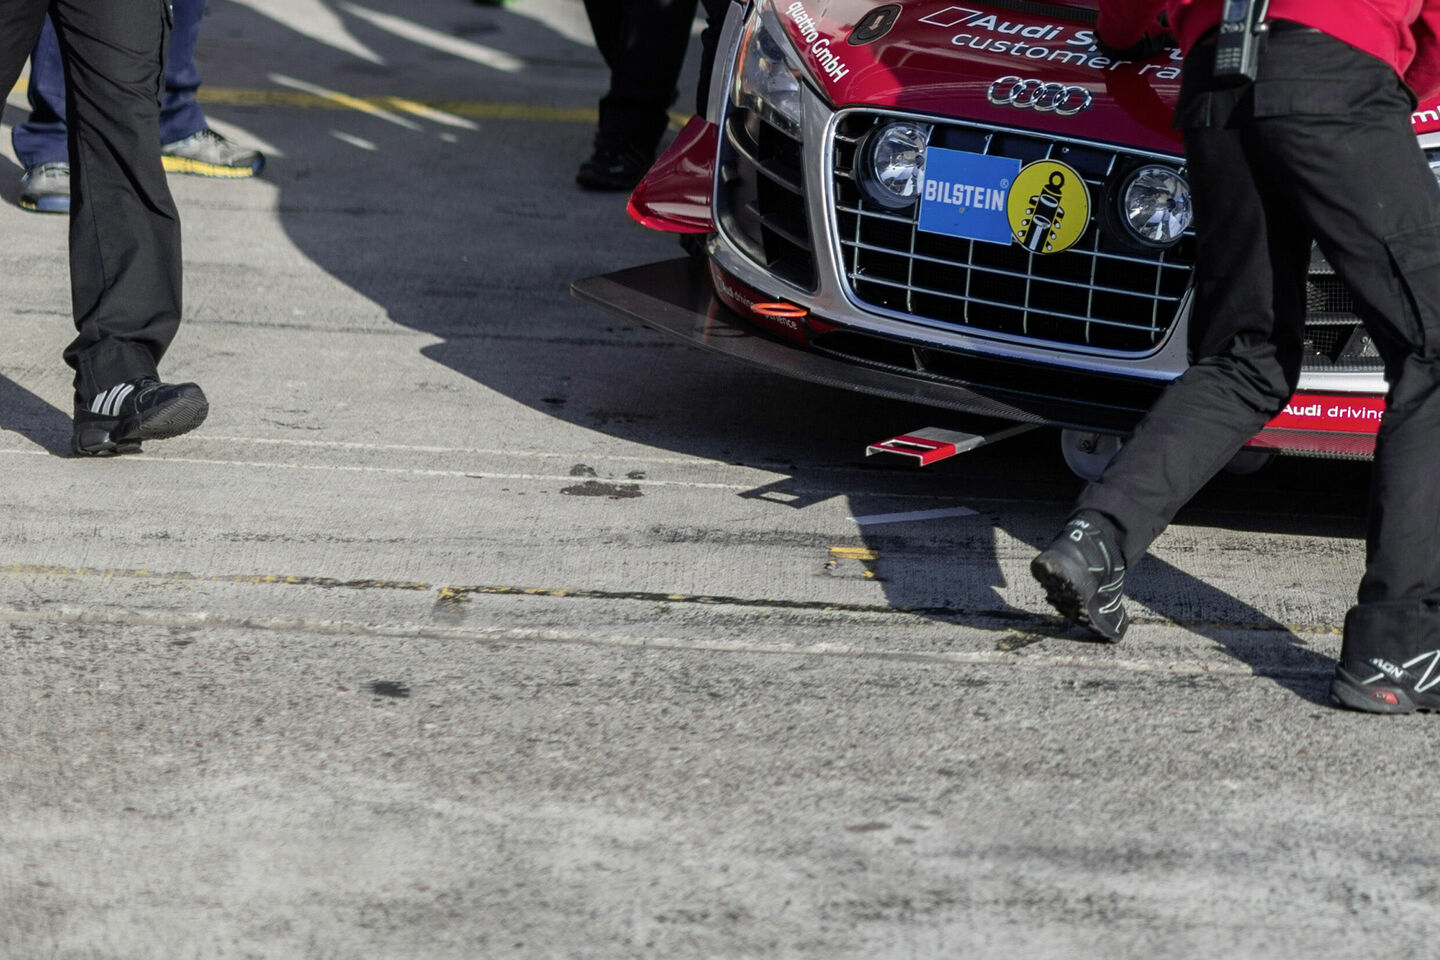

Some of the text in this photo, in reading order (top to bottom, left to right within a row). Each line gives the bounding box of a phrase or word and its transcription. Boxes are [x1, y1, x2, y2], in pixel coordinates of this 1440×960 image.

[788, 1, 850, 84] quattro GmbH
[966, 14, 1065, 41] Audi
[950, 32, 1133, 72] customer
[924, 179, 1005, 211] BILSTEIN
[1281, 404, 1322, 417] Audi
